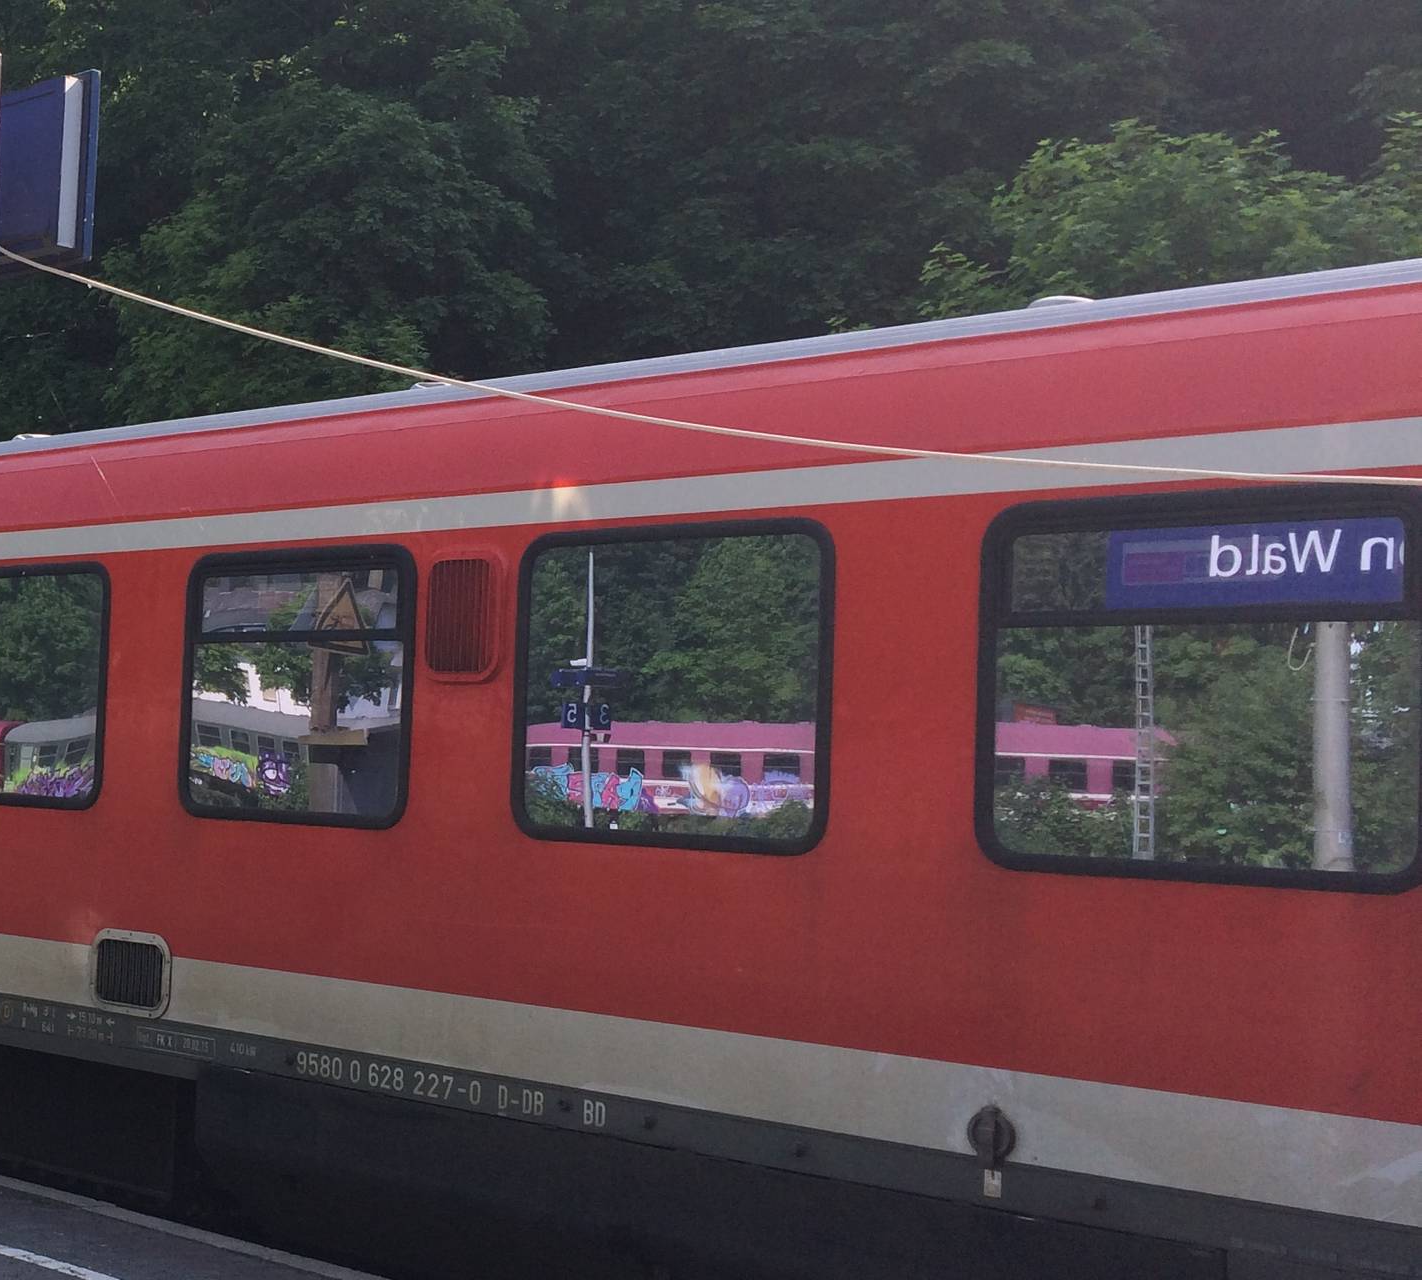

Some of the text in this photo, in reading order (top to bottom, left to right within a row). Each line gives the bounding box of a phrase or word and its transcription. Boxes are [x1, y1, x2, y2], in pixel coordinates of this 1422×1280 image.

[296, 1051, 544, 1117] 9580 0 628 227-0 D-DB
[583, 1099, 606, 1128] BD
